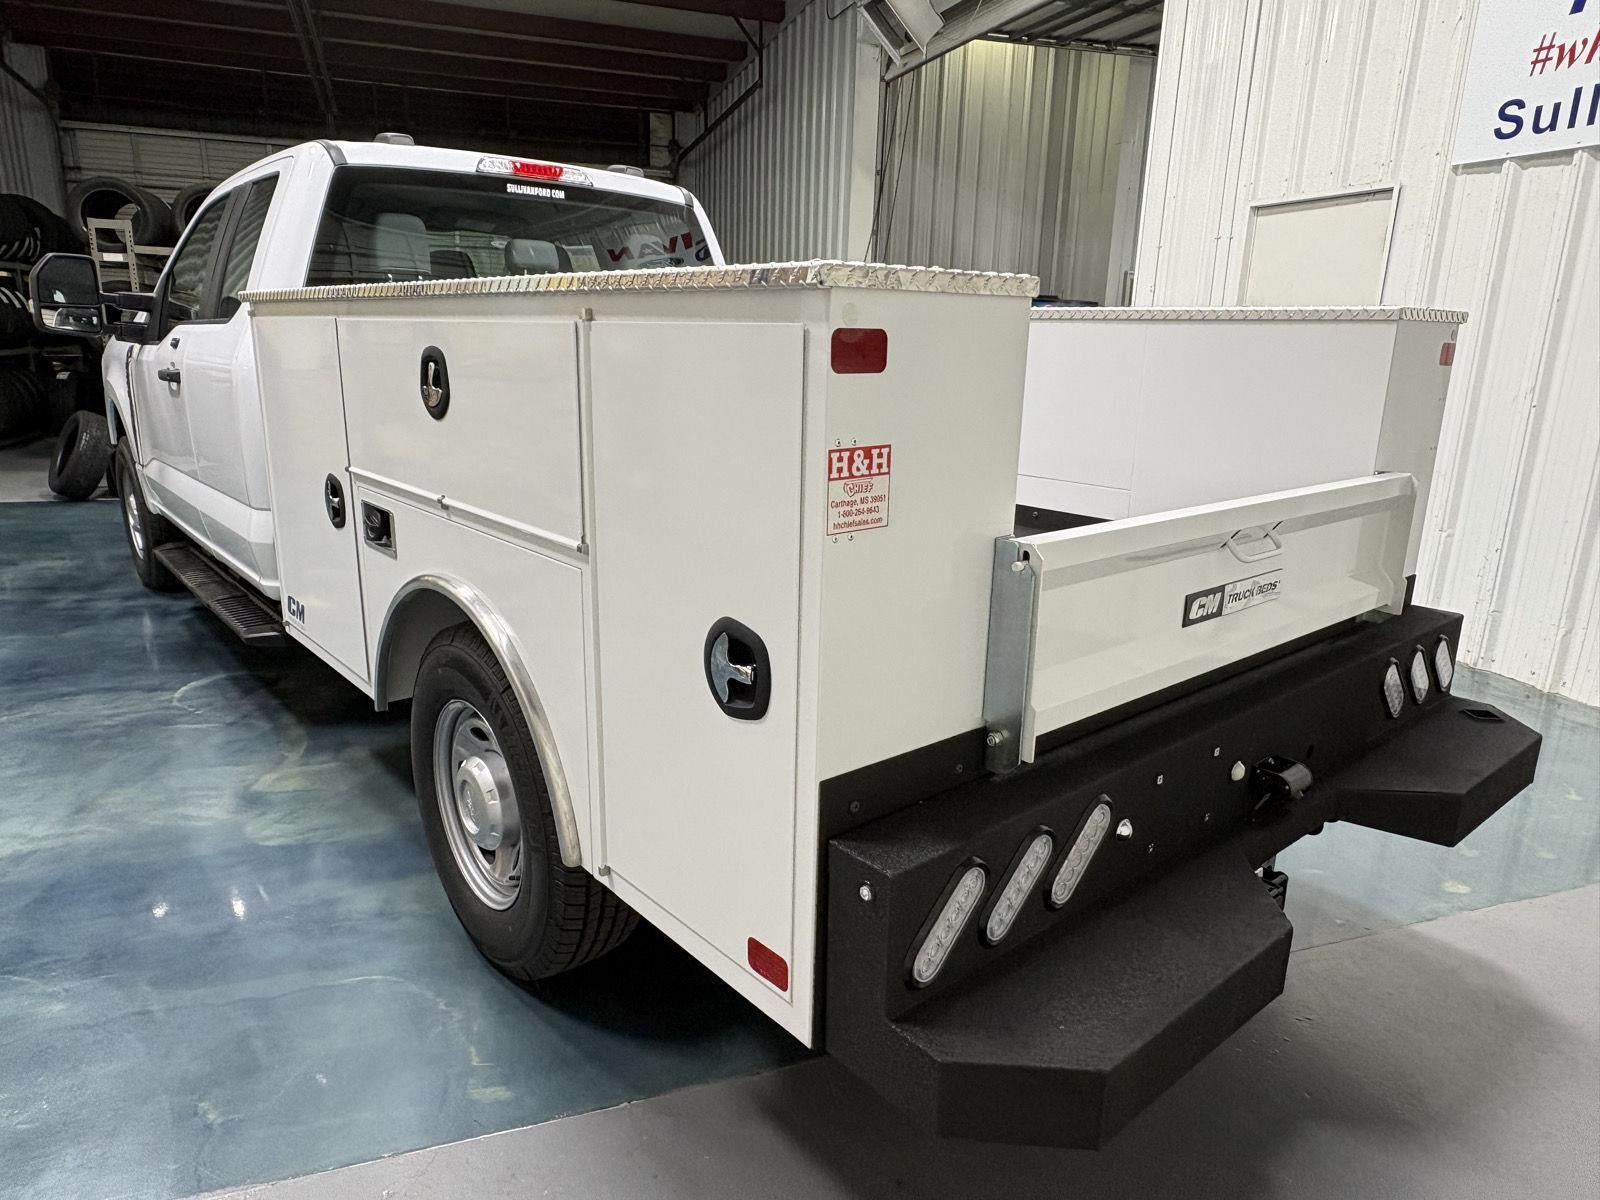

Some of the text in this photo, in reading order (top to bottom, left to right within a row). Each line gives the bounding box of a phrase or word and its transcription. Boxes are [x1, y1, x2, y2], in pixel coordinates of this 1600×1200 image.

[830, 448, 889, 479] H&H
[287, 595, 305, 625] CM
[1228, 588, 1255, 604] TRUCK
